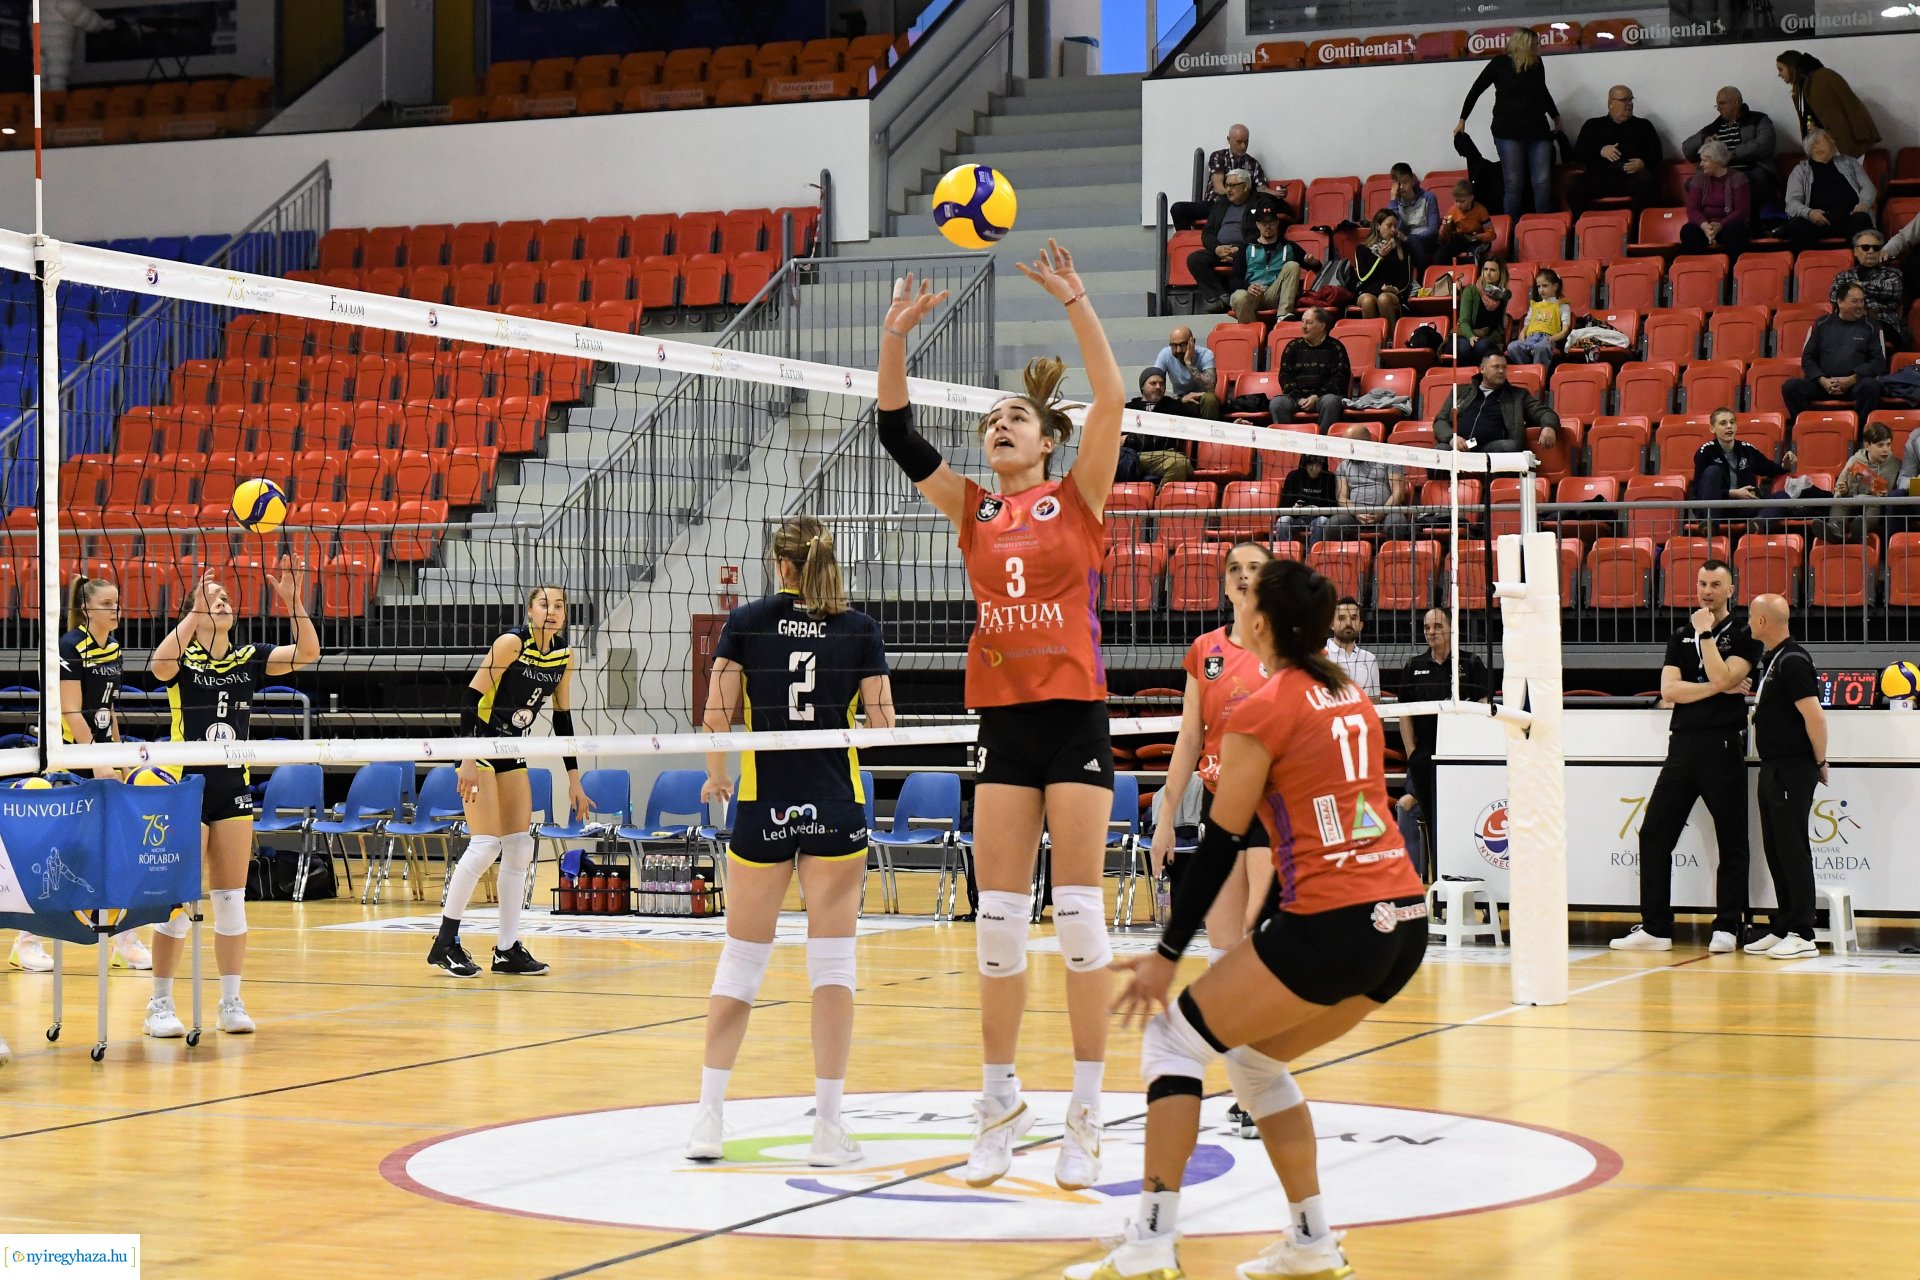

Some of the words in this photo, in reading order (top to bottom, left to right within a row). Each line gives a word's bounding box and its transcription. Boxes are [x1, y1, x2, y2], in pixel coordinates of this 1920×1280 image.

[1622, 21, 1711, 44] Continental
[1780, 10, 1873, 33] Continental
[1174, 50, 1257, 72] Continental
[1318, 38, 1404, 63] Continental
[1005, 556, 1026, 598] 3
[979, 600, 1064, 629] FATUM
[778, 619, 827, 638] GRBAC
[788, 651, 816, 721] 2
[1838, 672, 1876, 682] FATUM
[101, 681, 114, 704] 11
[216, 690, 229, 718] 6
[526, 687, 542, 706] 9
[1331, 713, 1368, 782] 17
[976, 746, 988, 773] 3
[4, 798, 94, 818] HUNVOLLEY
[762, 827, 787, 841] Led
[138, 853, 180, 864] RÖPLABDA
